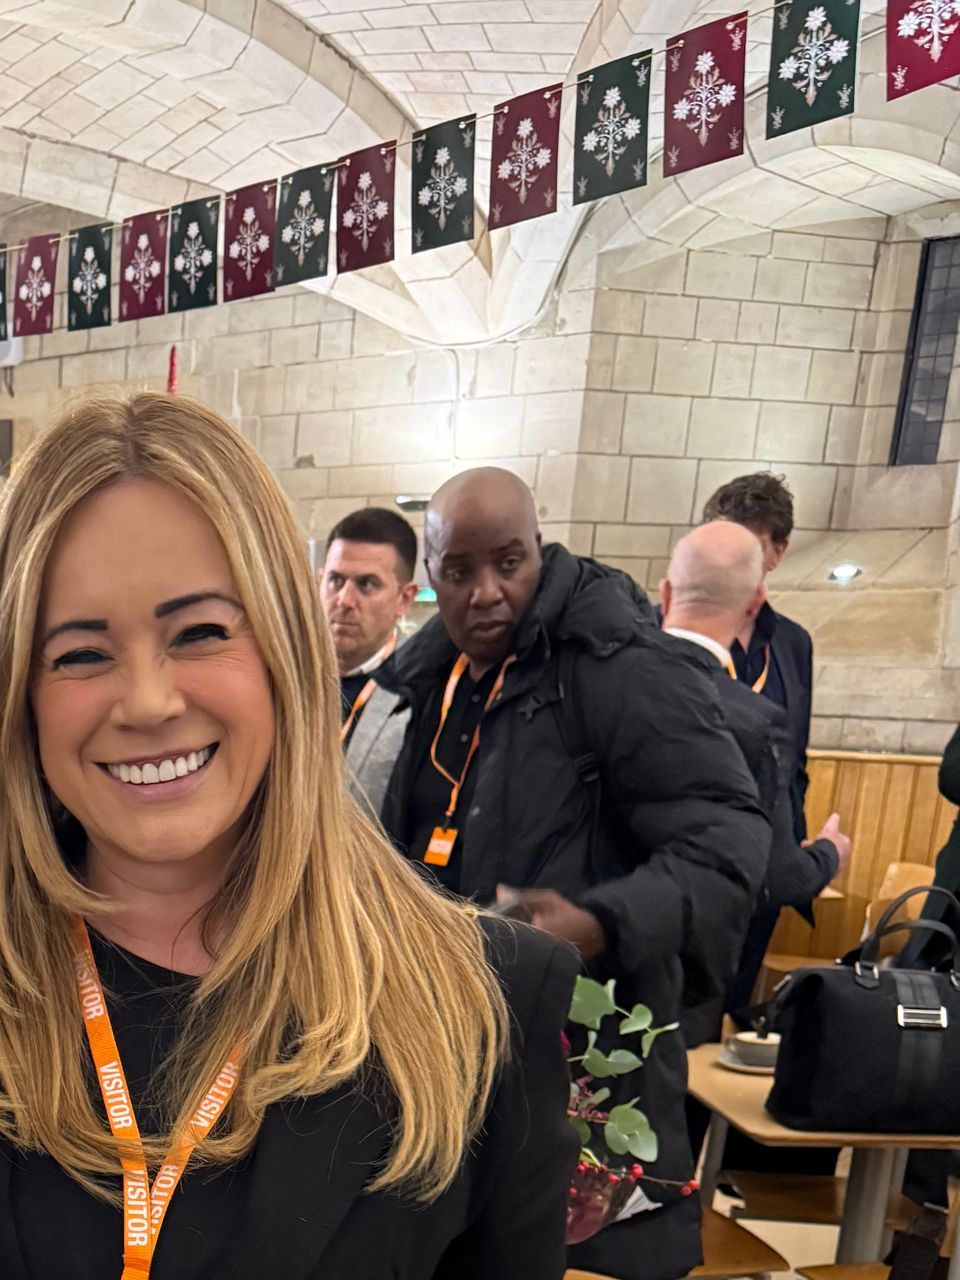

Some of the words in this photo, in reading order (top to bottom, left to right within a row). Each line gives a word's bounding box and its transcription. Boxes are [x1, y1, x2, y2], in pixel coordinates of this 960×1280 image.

[99, 1060, 133, 1129] VISITOR
[190, 1062, 240, 1128] VISITOR
[127, 1170, 149, 1247] VISITOR
